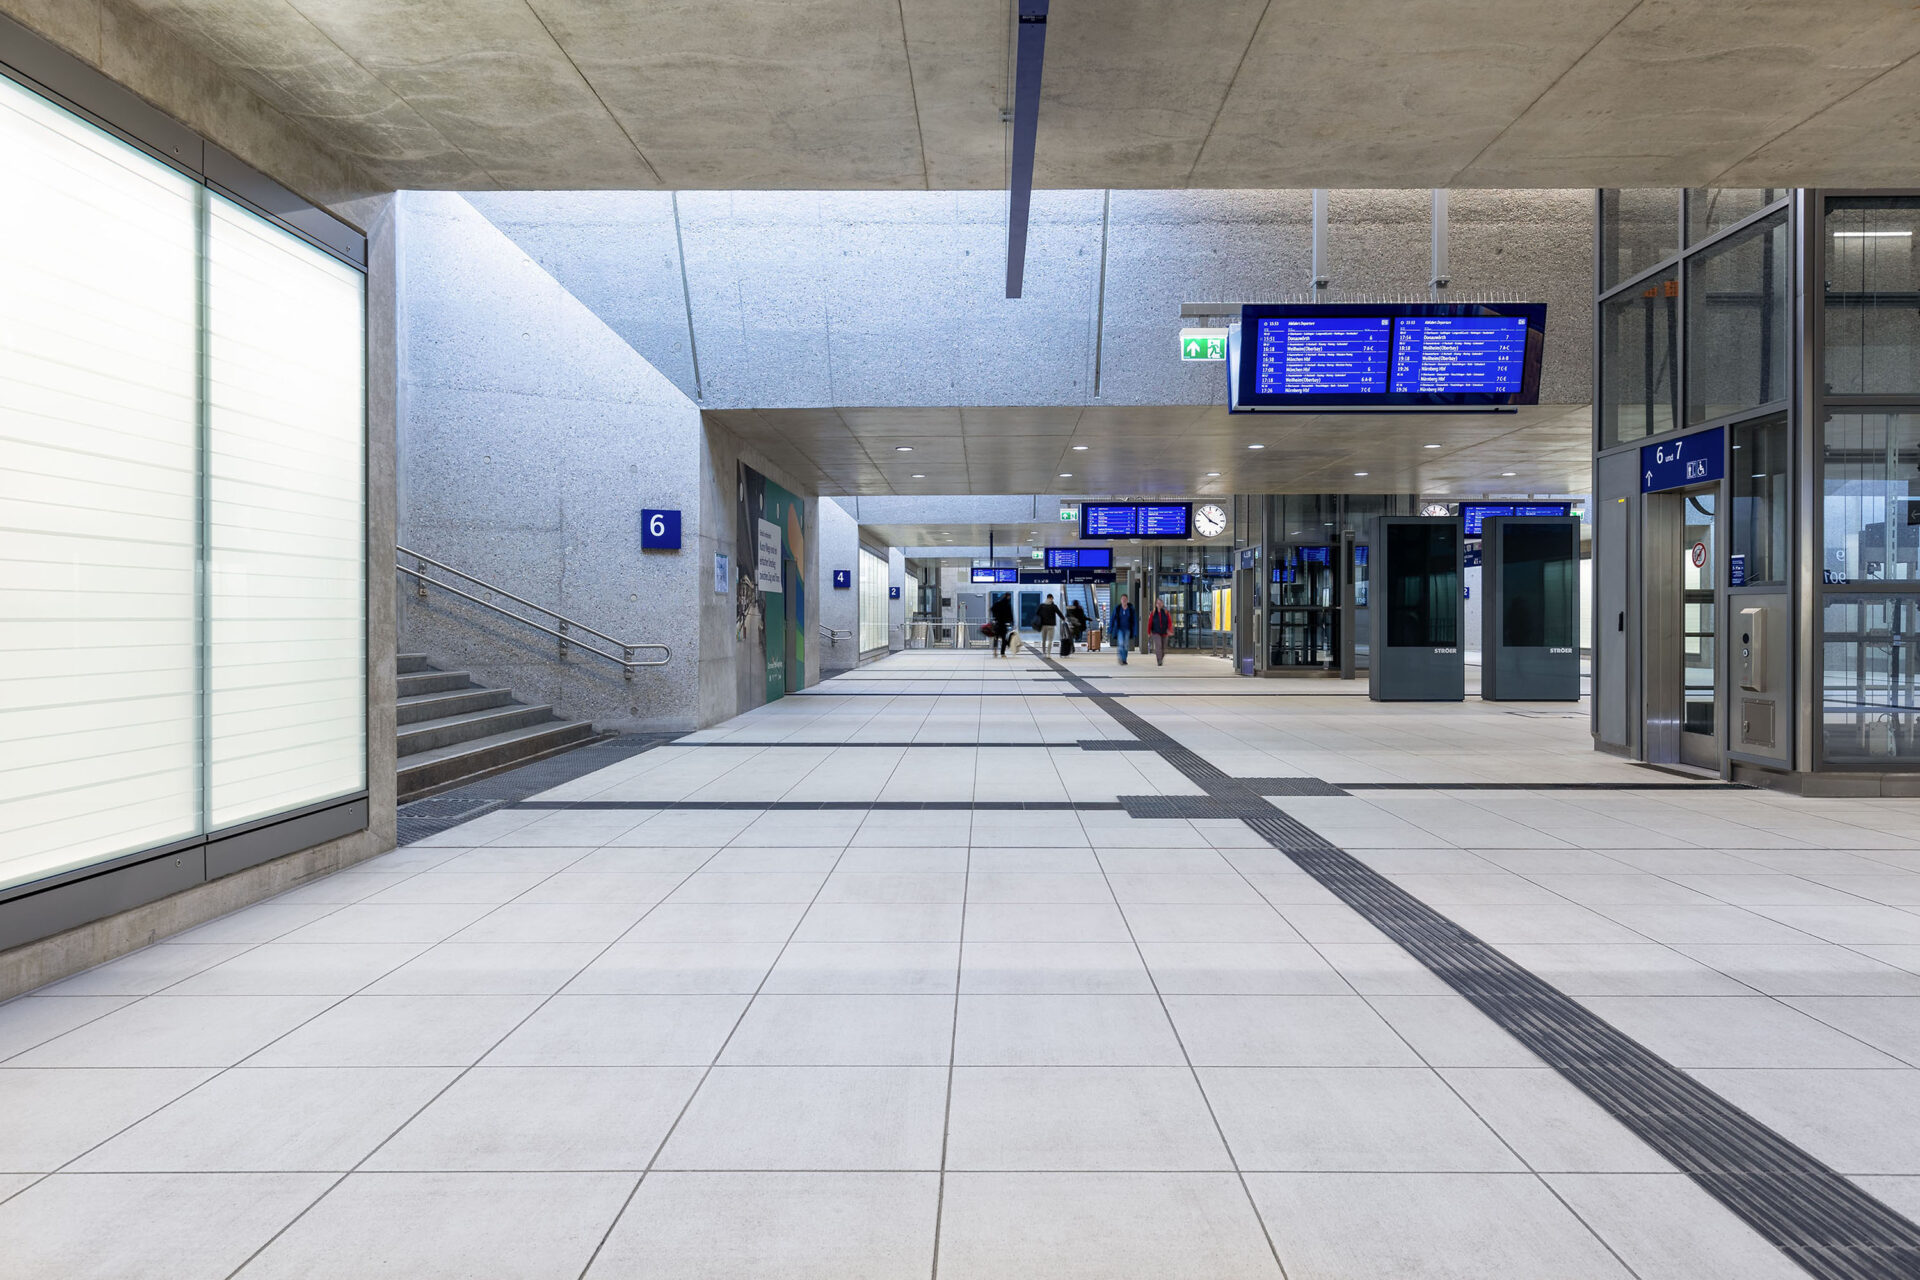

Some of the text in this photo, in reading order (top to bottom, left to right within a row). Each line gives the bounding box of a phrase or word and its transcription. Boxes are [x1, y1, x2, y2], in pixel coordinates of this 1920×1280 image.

[1656, 441, 1683, 464] 6 und 7
[650, 514, 665, 537] 6
[837, 572, 844, 583] 4
[891, 588, 896, 596] 2
